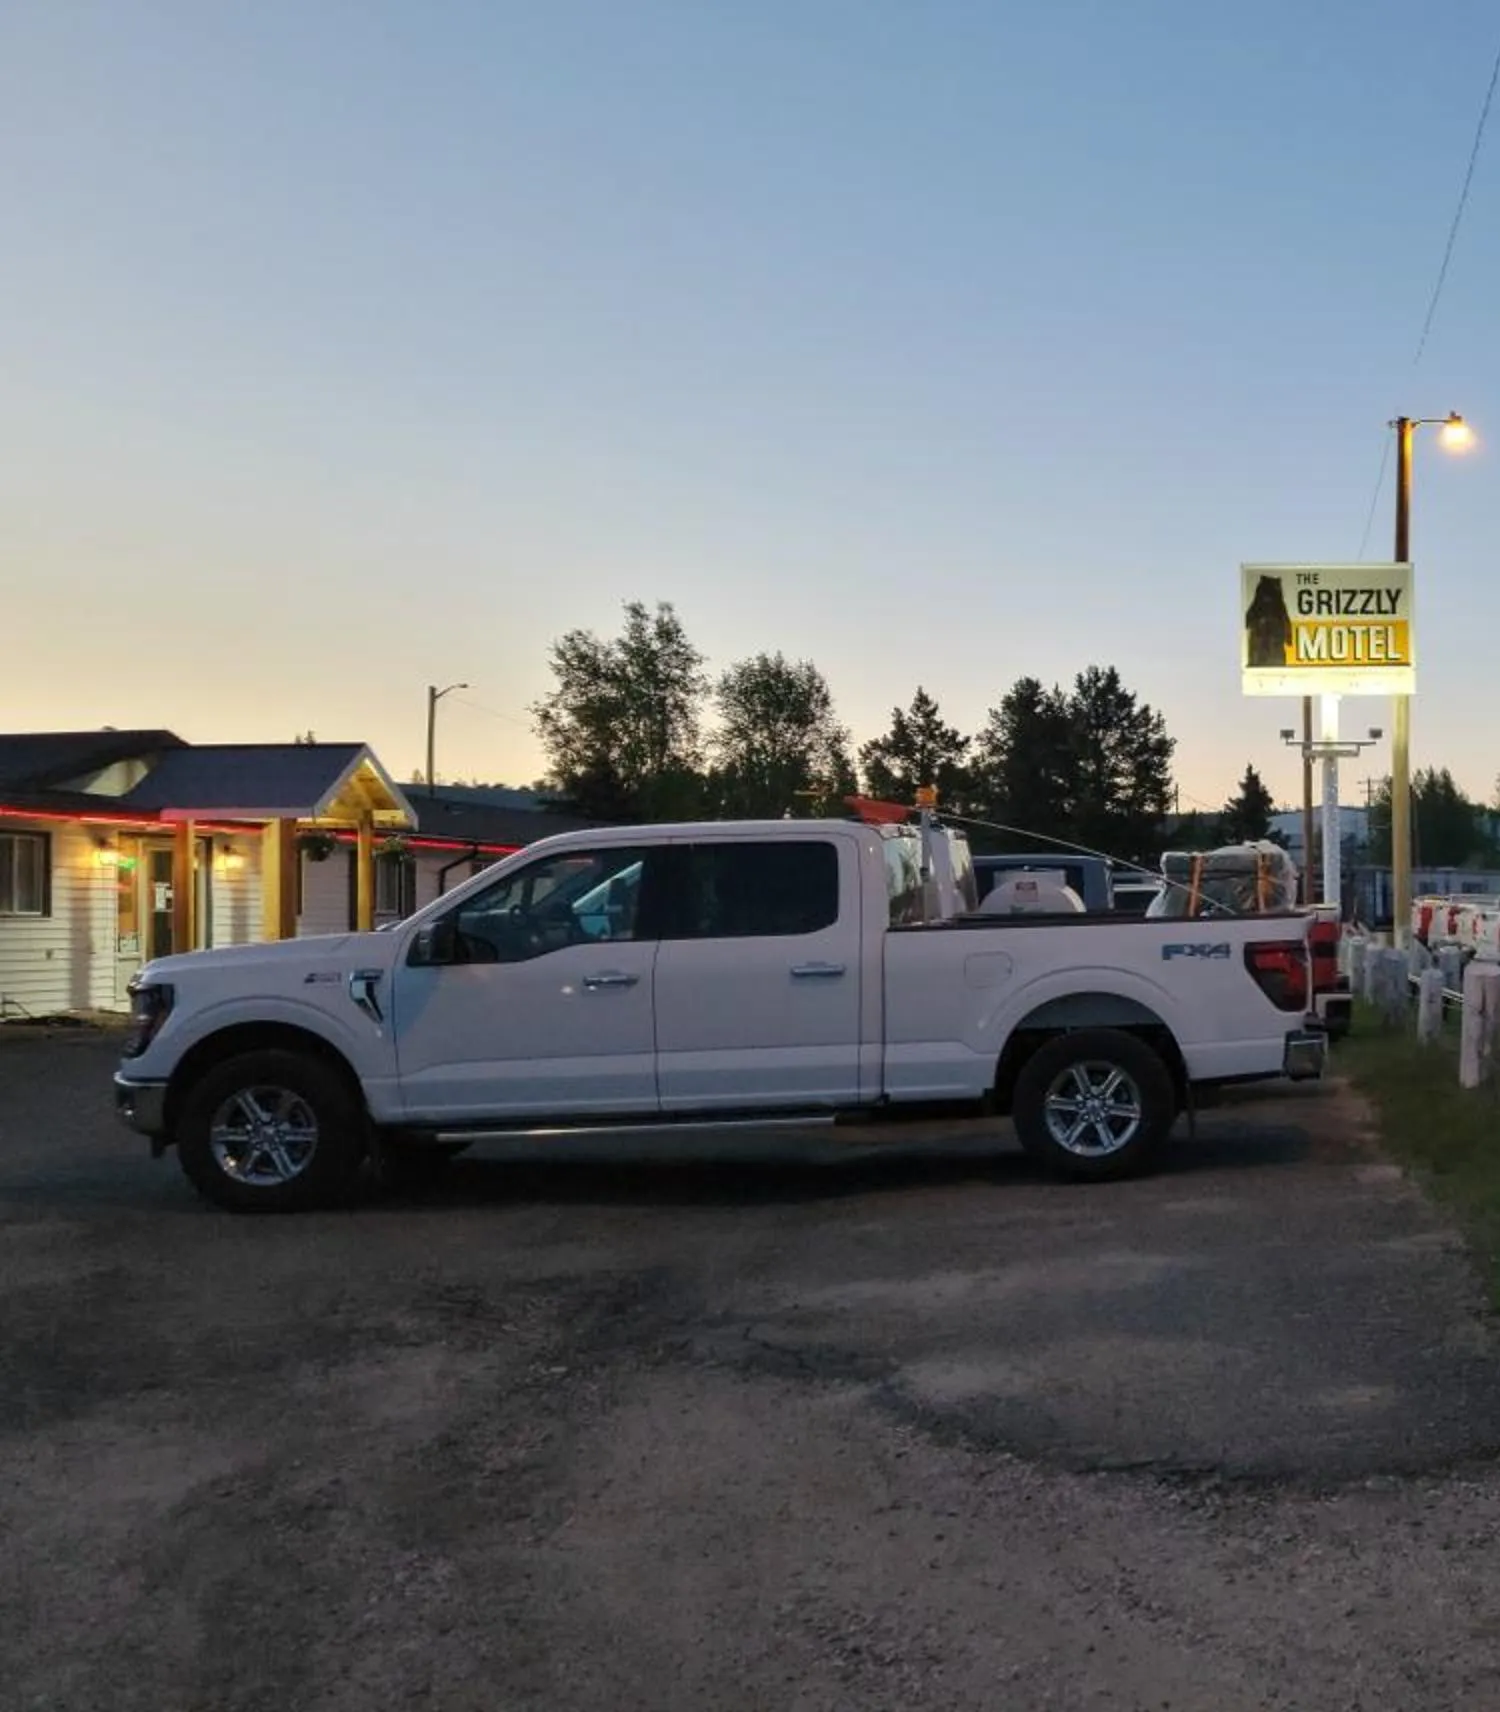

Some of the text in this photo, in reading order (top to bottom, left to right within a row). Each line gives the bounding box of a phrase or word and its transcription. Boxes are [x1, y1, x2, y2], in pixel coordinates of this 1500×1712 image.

[1296, 573, 1320, 585] THE
[1297, 589, 1402, 615] GRIZZLY
[1296, 625, 1402, 661] MOTEL
[1162, 943, 1230, 960] FX4
